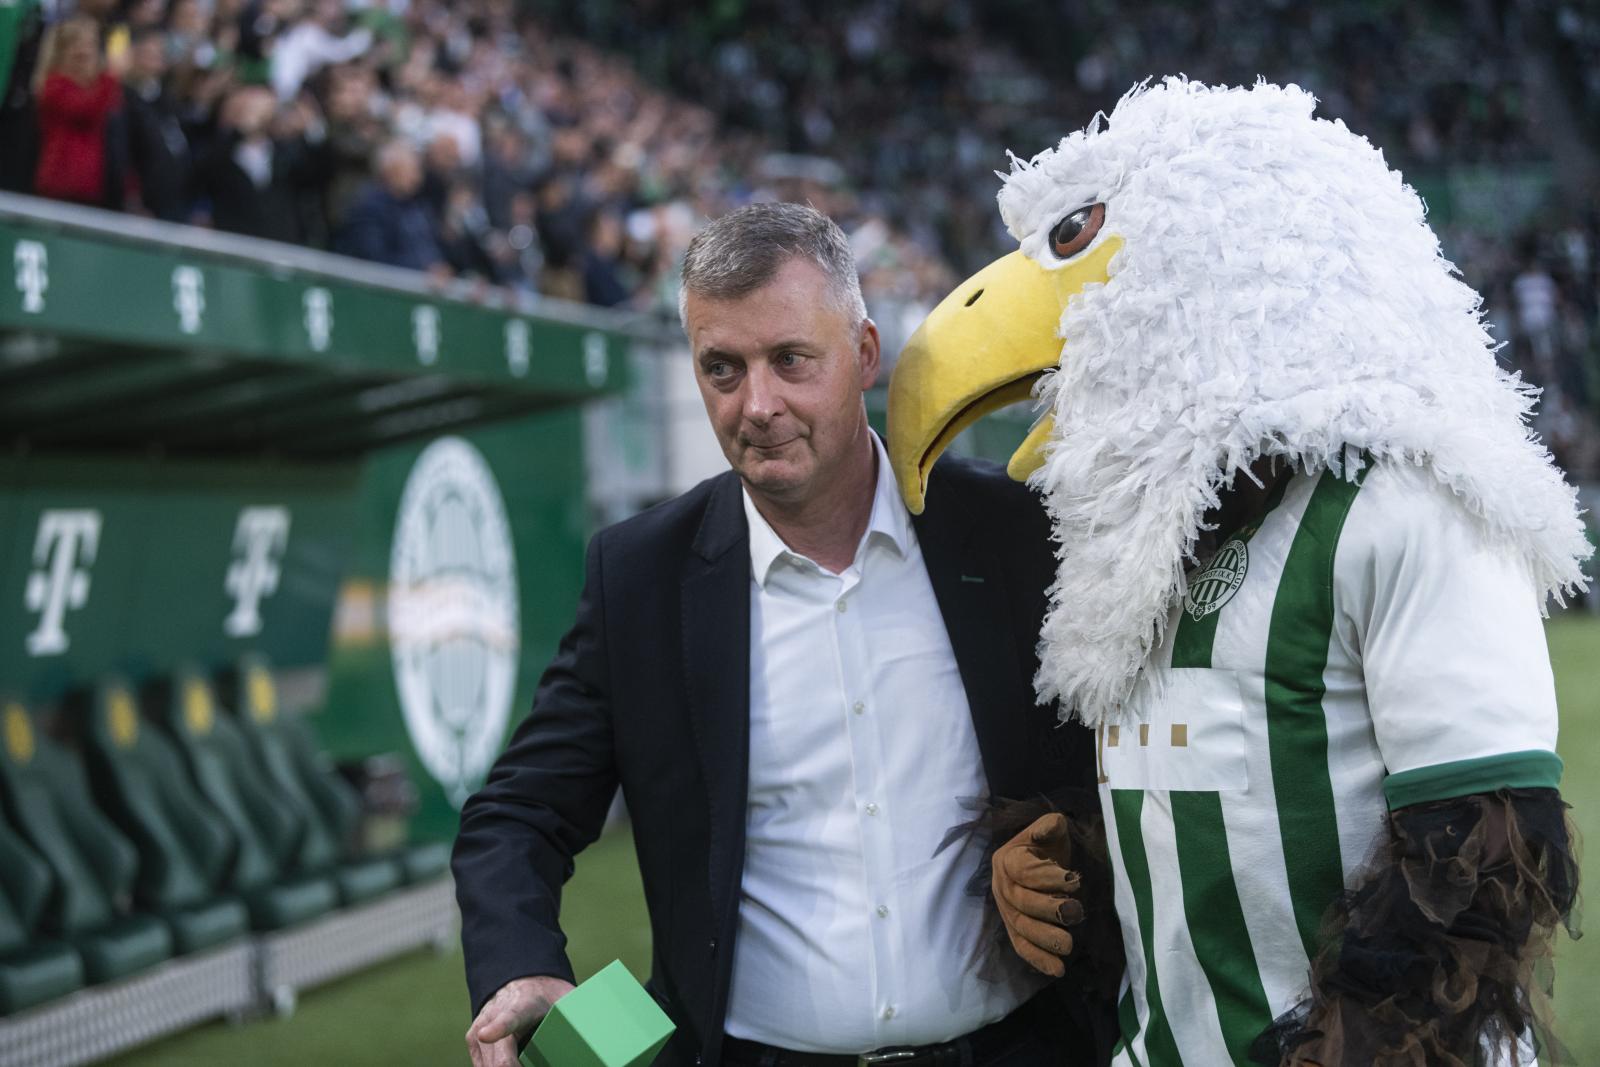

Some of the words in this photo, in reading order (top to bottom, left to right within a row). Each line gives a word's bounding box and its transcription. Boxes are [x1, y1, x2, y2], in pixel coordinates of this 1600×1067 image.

[14, 240, 48, 312] T
[25, 510, 102, 655] T
[225, 507, 289, 636] T
[1208, 602, 1217, 612] 99
[1231, 565, 1246, 590] CLUB
